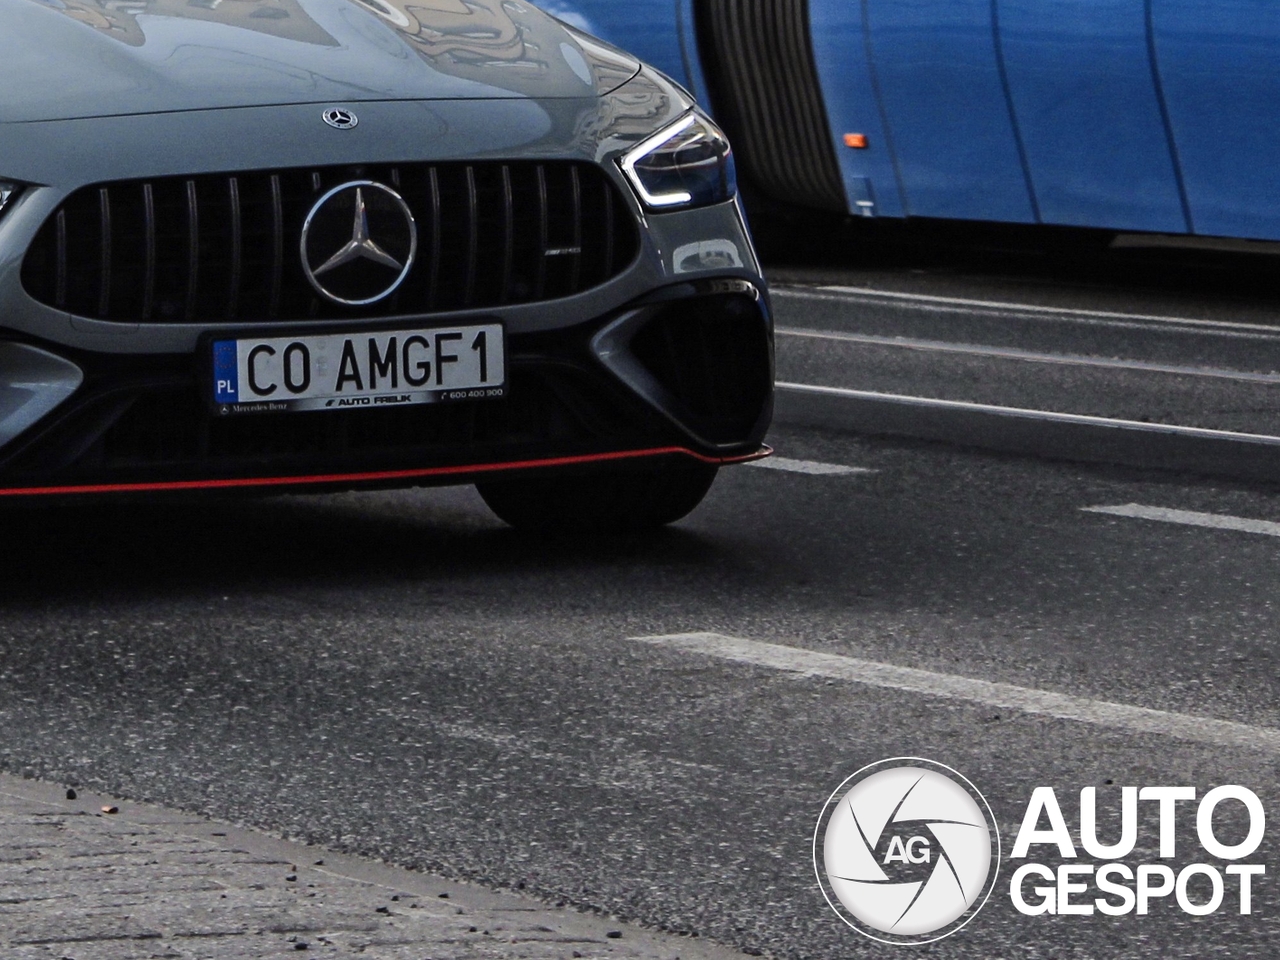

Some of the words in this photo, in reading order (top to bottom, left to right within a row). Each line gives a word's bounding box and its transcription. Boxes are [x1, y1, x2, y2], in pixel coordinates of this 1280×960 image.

[335, 331, 488, 392] AMGF1
[217, 380, 235, 394] PL
[338, 397, 370, 406] AUTO
